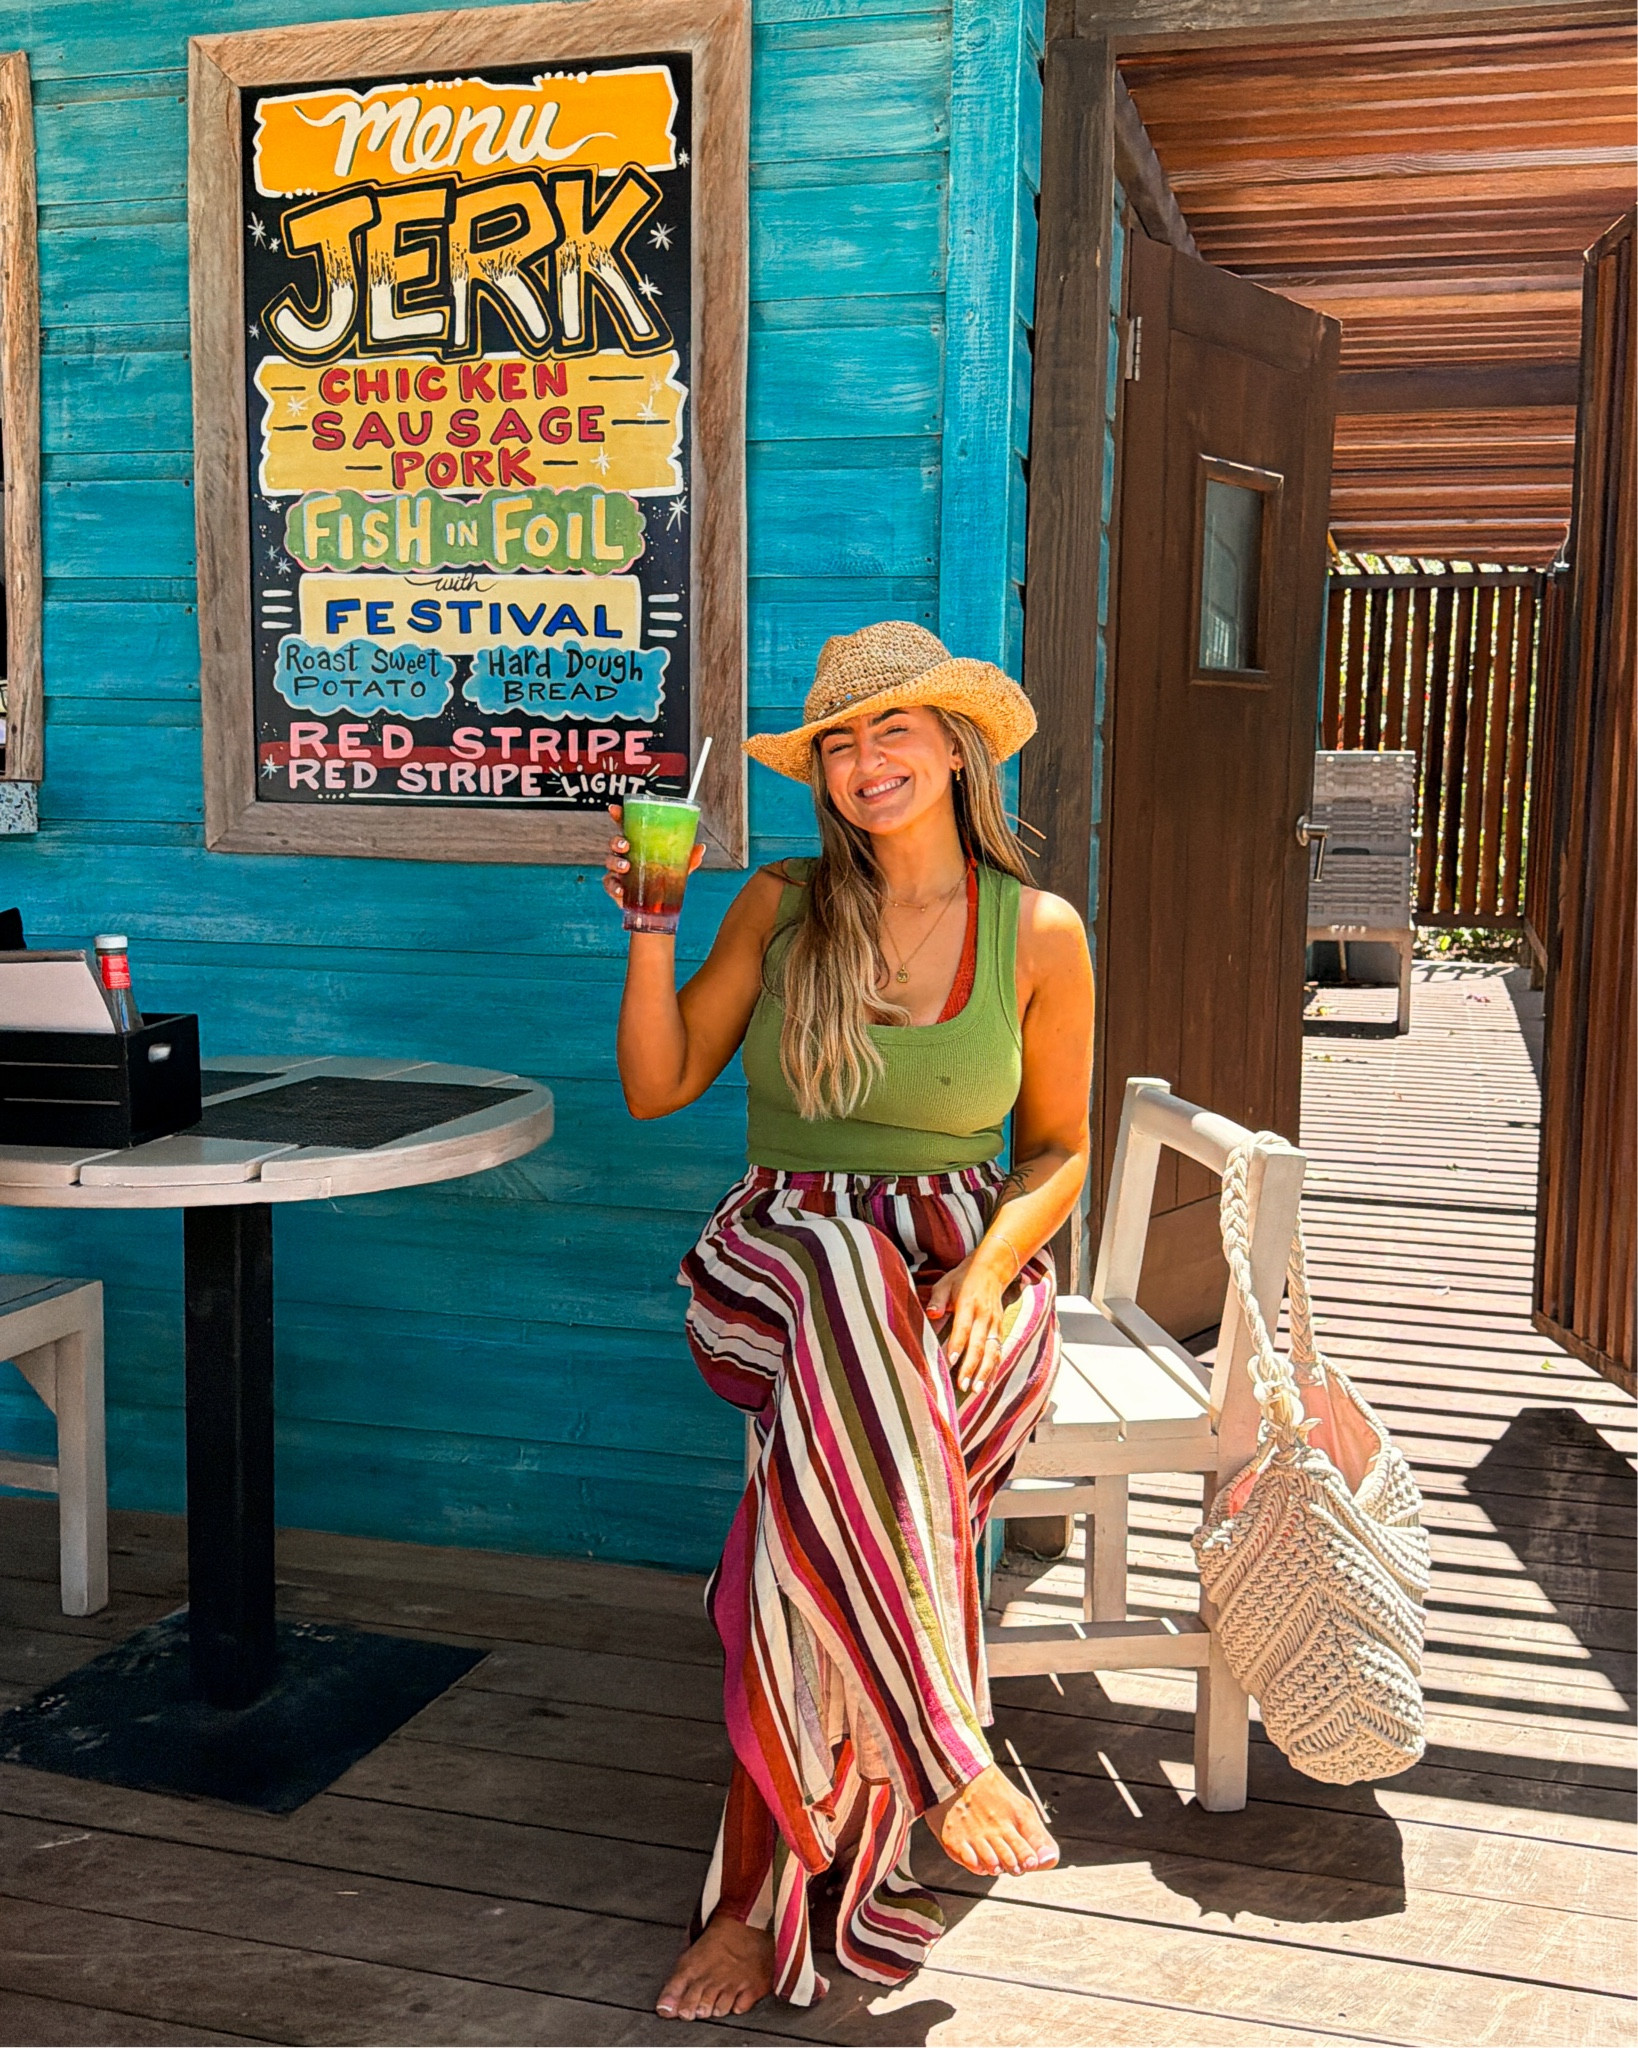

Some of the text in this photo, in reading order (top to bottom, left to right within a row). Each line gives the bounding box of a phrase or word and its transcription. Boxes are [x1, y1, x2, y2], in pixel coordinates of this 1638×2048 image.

[294, 96, 618, 177] Menu
[262, 163, 674, 364] JERK
[318, 361, 568, 405] CHICKEN
[312, 405, 605, 449] SAUSAGE
[391, 446, 536, 488] PORK
[303, 493, 624, 565] FISH IN FOIL
[404, 574, 498, 593] with
[326, 598, 622, 639] FESTIVAL
[285, 643, 440, 678] Roast Sweet
[487, 647, 642, 682] Hard Dough
[294, 678, 426, 698] POTATO
[504, 680, 618, 703] BREAD
[290, 722, 652, 765] RED STRIPE
[289, 759, 377, 790] RED
[397, 764, 542, 796] STRIPE
